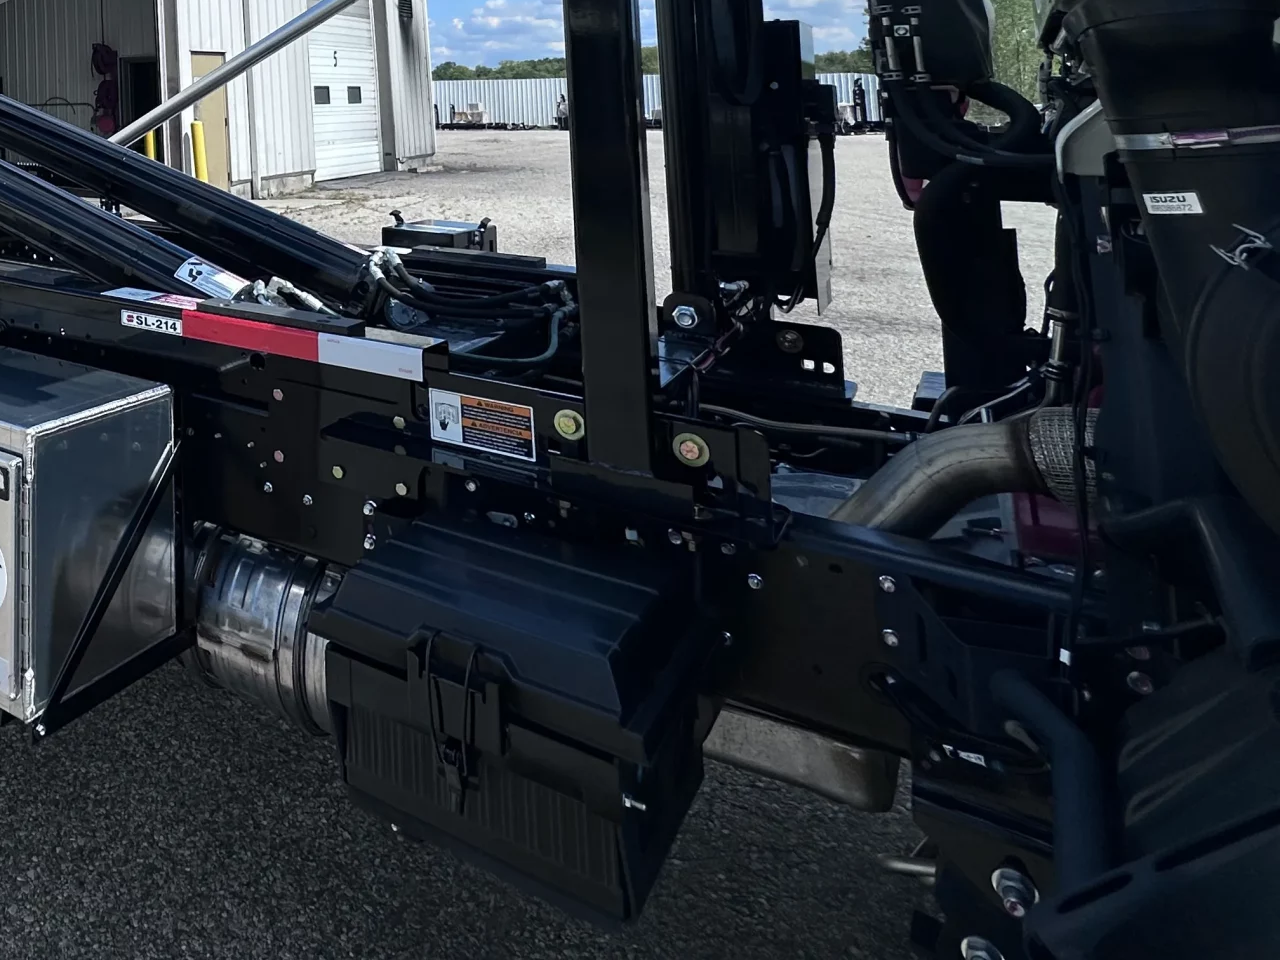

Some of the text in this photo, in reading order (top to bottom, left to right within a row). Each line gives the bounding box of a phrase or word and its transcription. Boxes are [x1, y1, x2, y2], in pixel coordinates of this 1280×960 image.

[333, 50, 337, 67] 5
[1149, 195, 1186, 203] ISUZU
[135, 315, 178, 332] SL-214
[483, 401, 515, 413] WARNING
[478, 422, 524, 437] ADVERTENCIA
